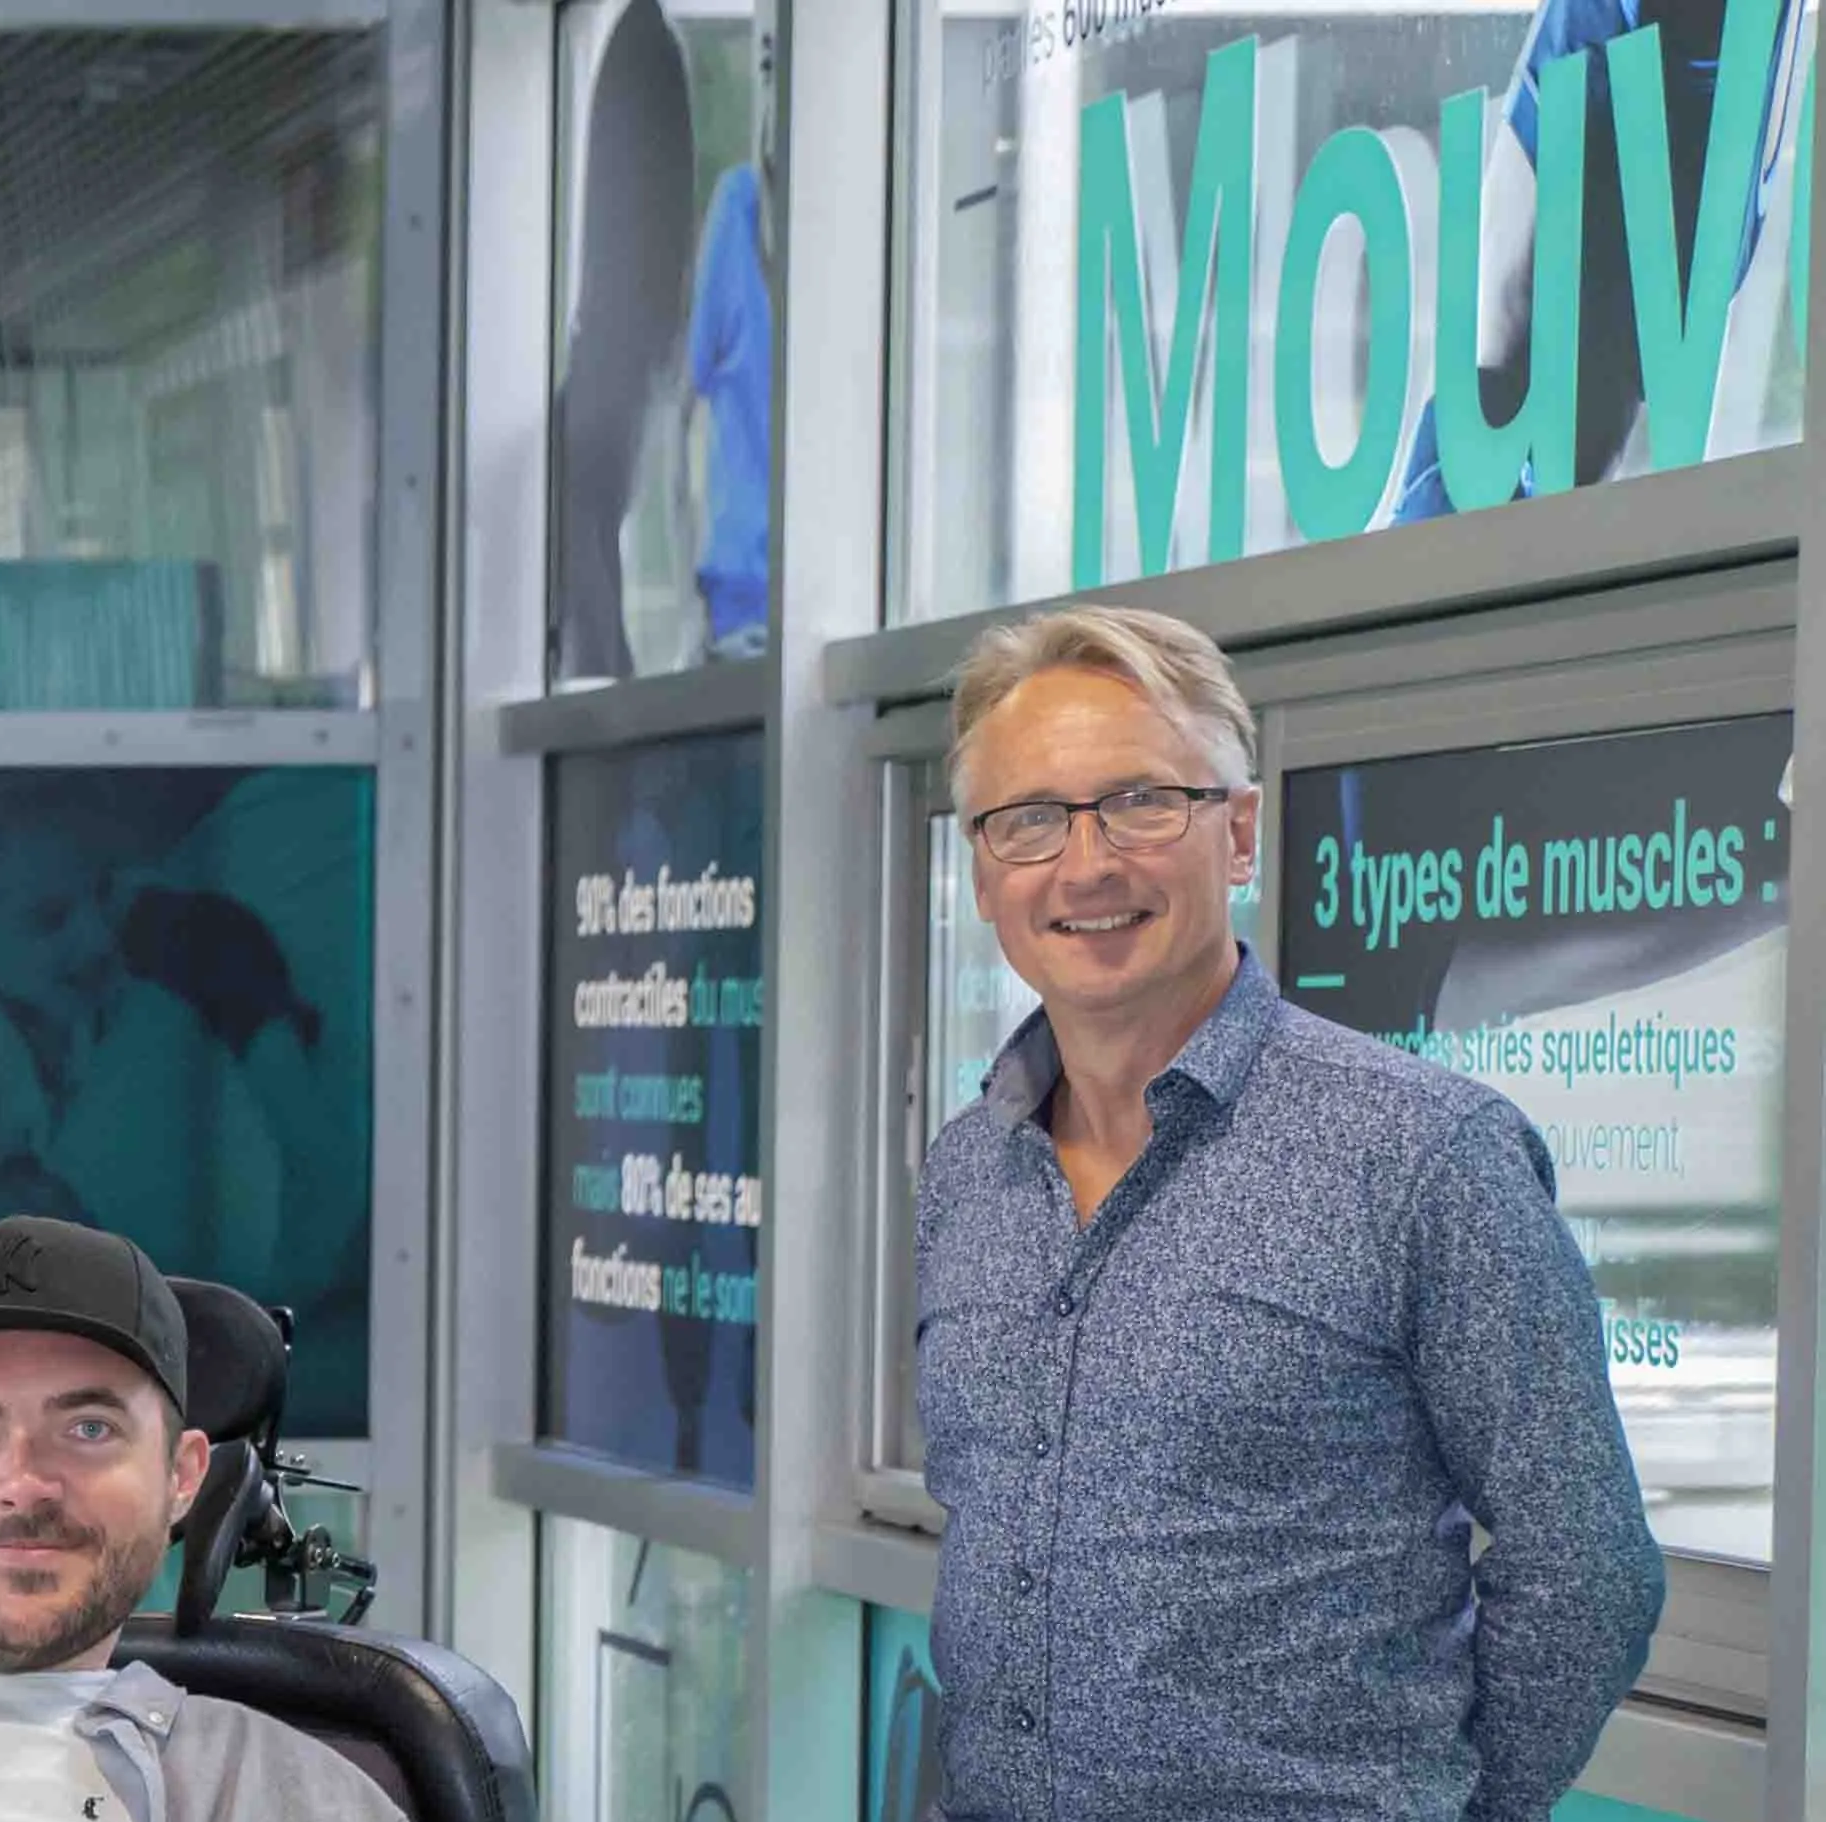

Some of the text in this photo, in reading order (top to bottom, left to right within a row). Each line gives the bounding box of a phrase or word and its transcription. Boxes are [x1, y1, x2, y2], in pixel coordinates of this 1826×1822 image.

[1072, 0, 1814, 592] Mouv
[576, 859, 755, 937] 90% des fonctions
[1314, 835, 1339, 929] 3
[1350, 838, 1463, 951] types
[1476, 815, 1530, 919] de
[1543, 798, 1745, 915] muscles
[574, 961, 688, 1028] contractiles
[689, 960, 719, 1028] du
[1542, 1012, 1737, 1091] squelettiques
[665, 1152, 693, 1222] de
[694, 1171, 733, 1226] ses
[571, 1236, 661, 1312] fonctions
[662, 1263, 689, 1317] ne
[691, 1246, 713, 1320] le
